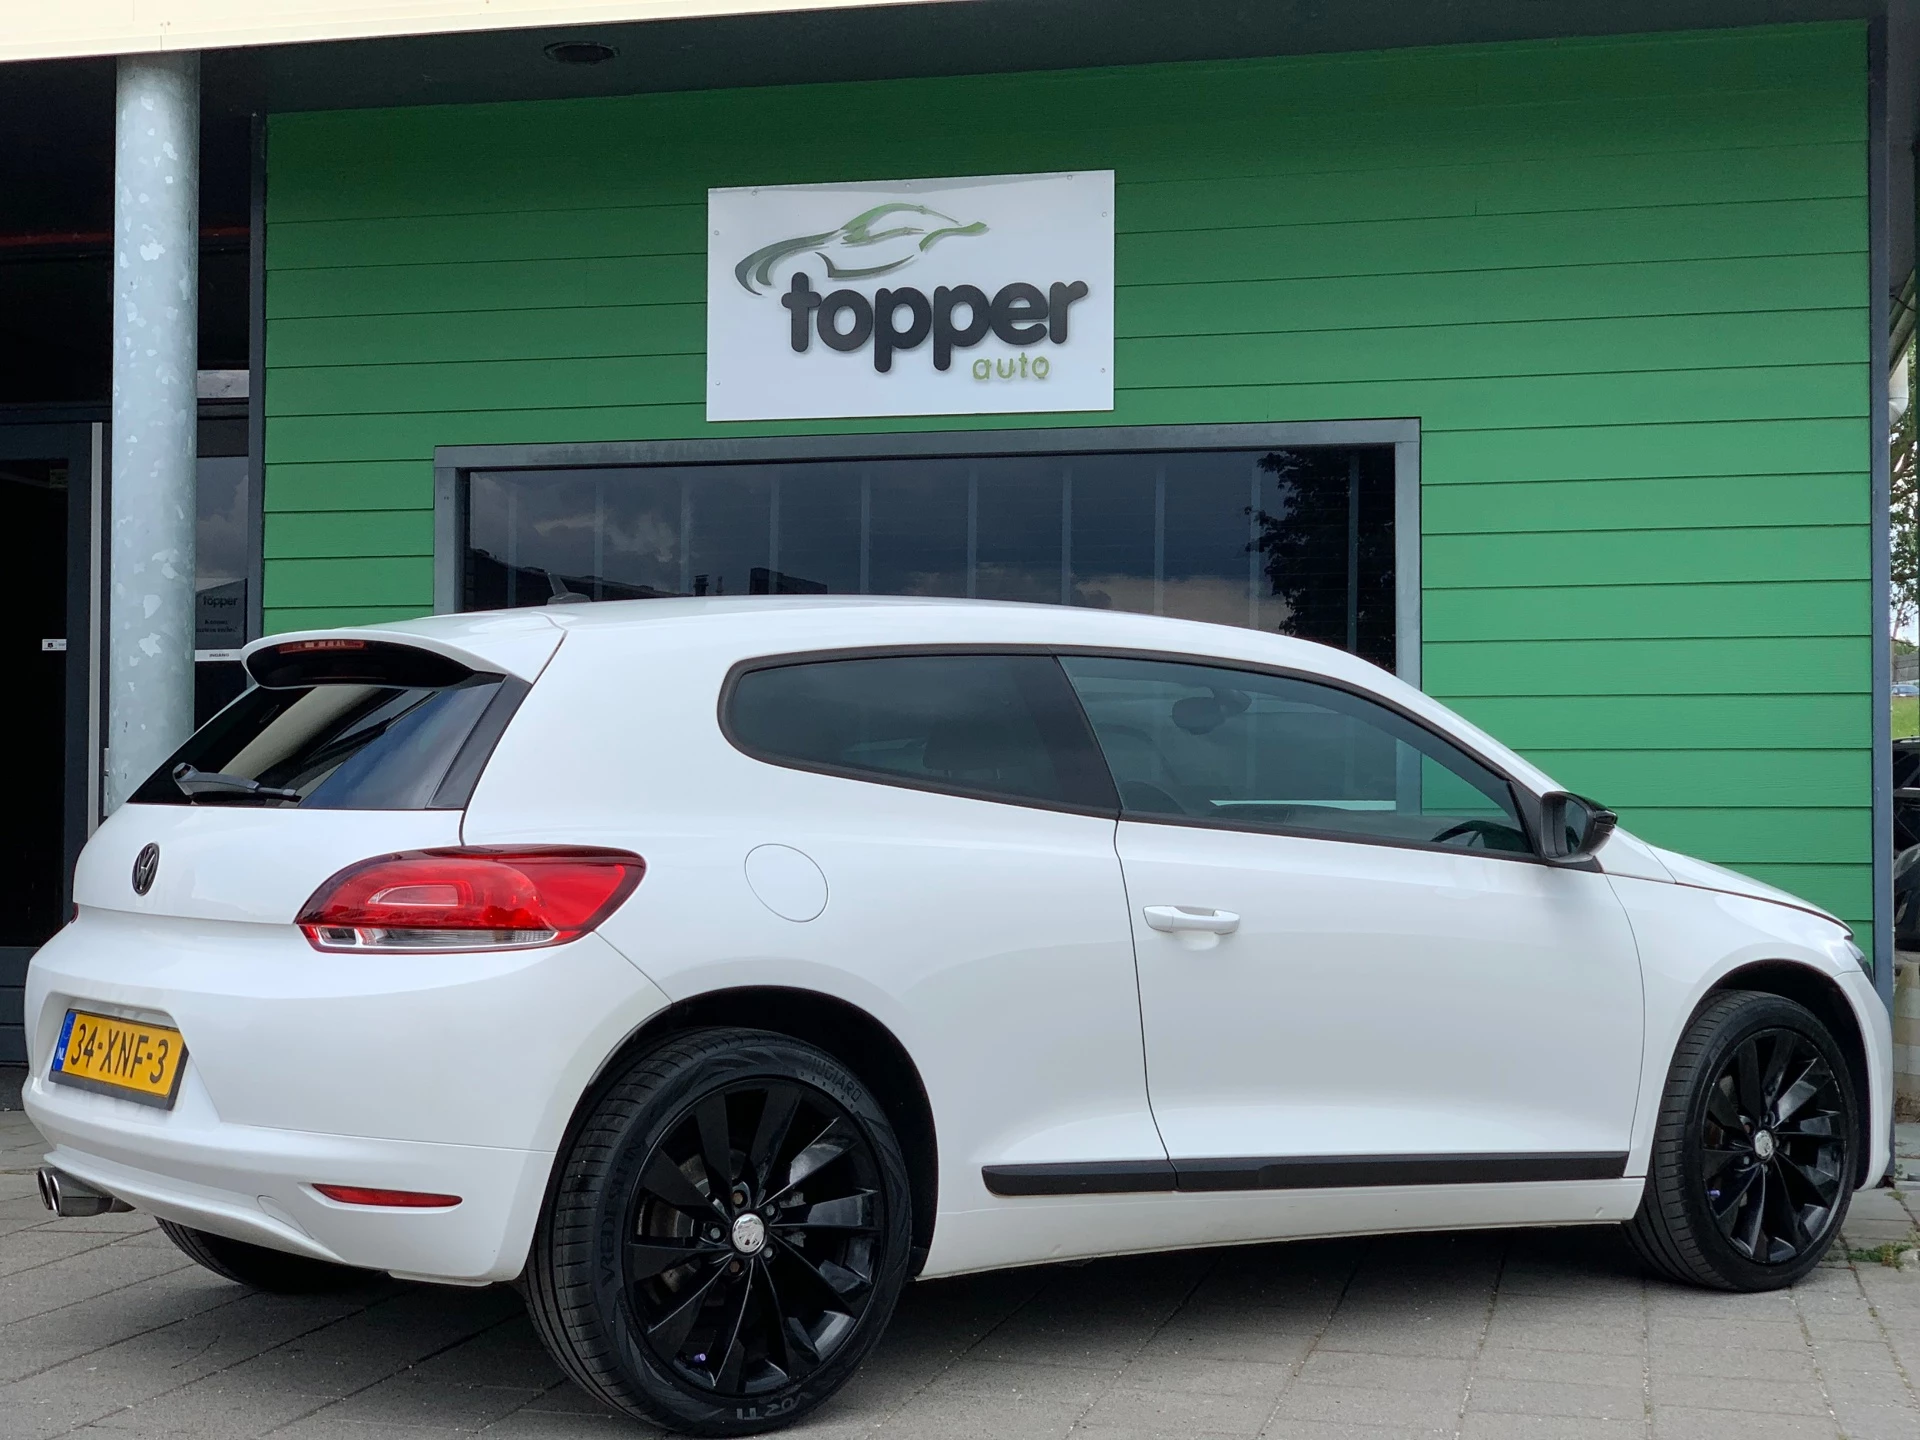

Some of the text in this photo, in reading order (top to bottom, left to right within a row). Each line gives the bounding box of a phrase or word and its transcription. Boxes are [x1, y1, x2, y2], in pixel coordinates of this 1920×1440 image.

[781, 271, 1089, 373] topper
[972, 352, 1050, 380] auto
[202, 595, 238, 608] topper
[70, 1023, 169, 1084] 34-XNF-3
